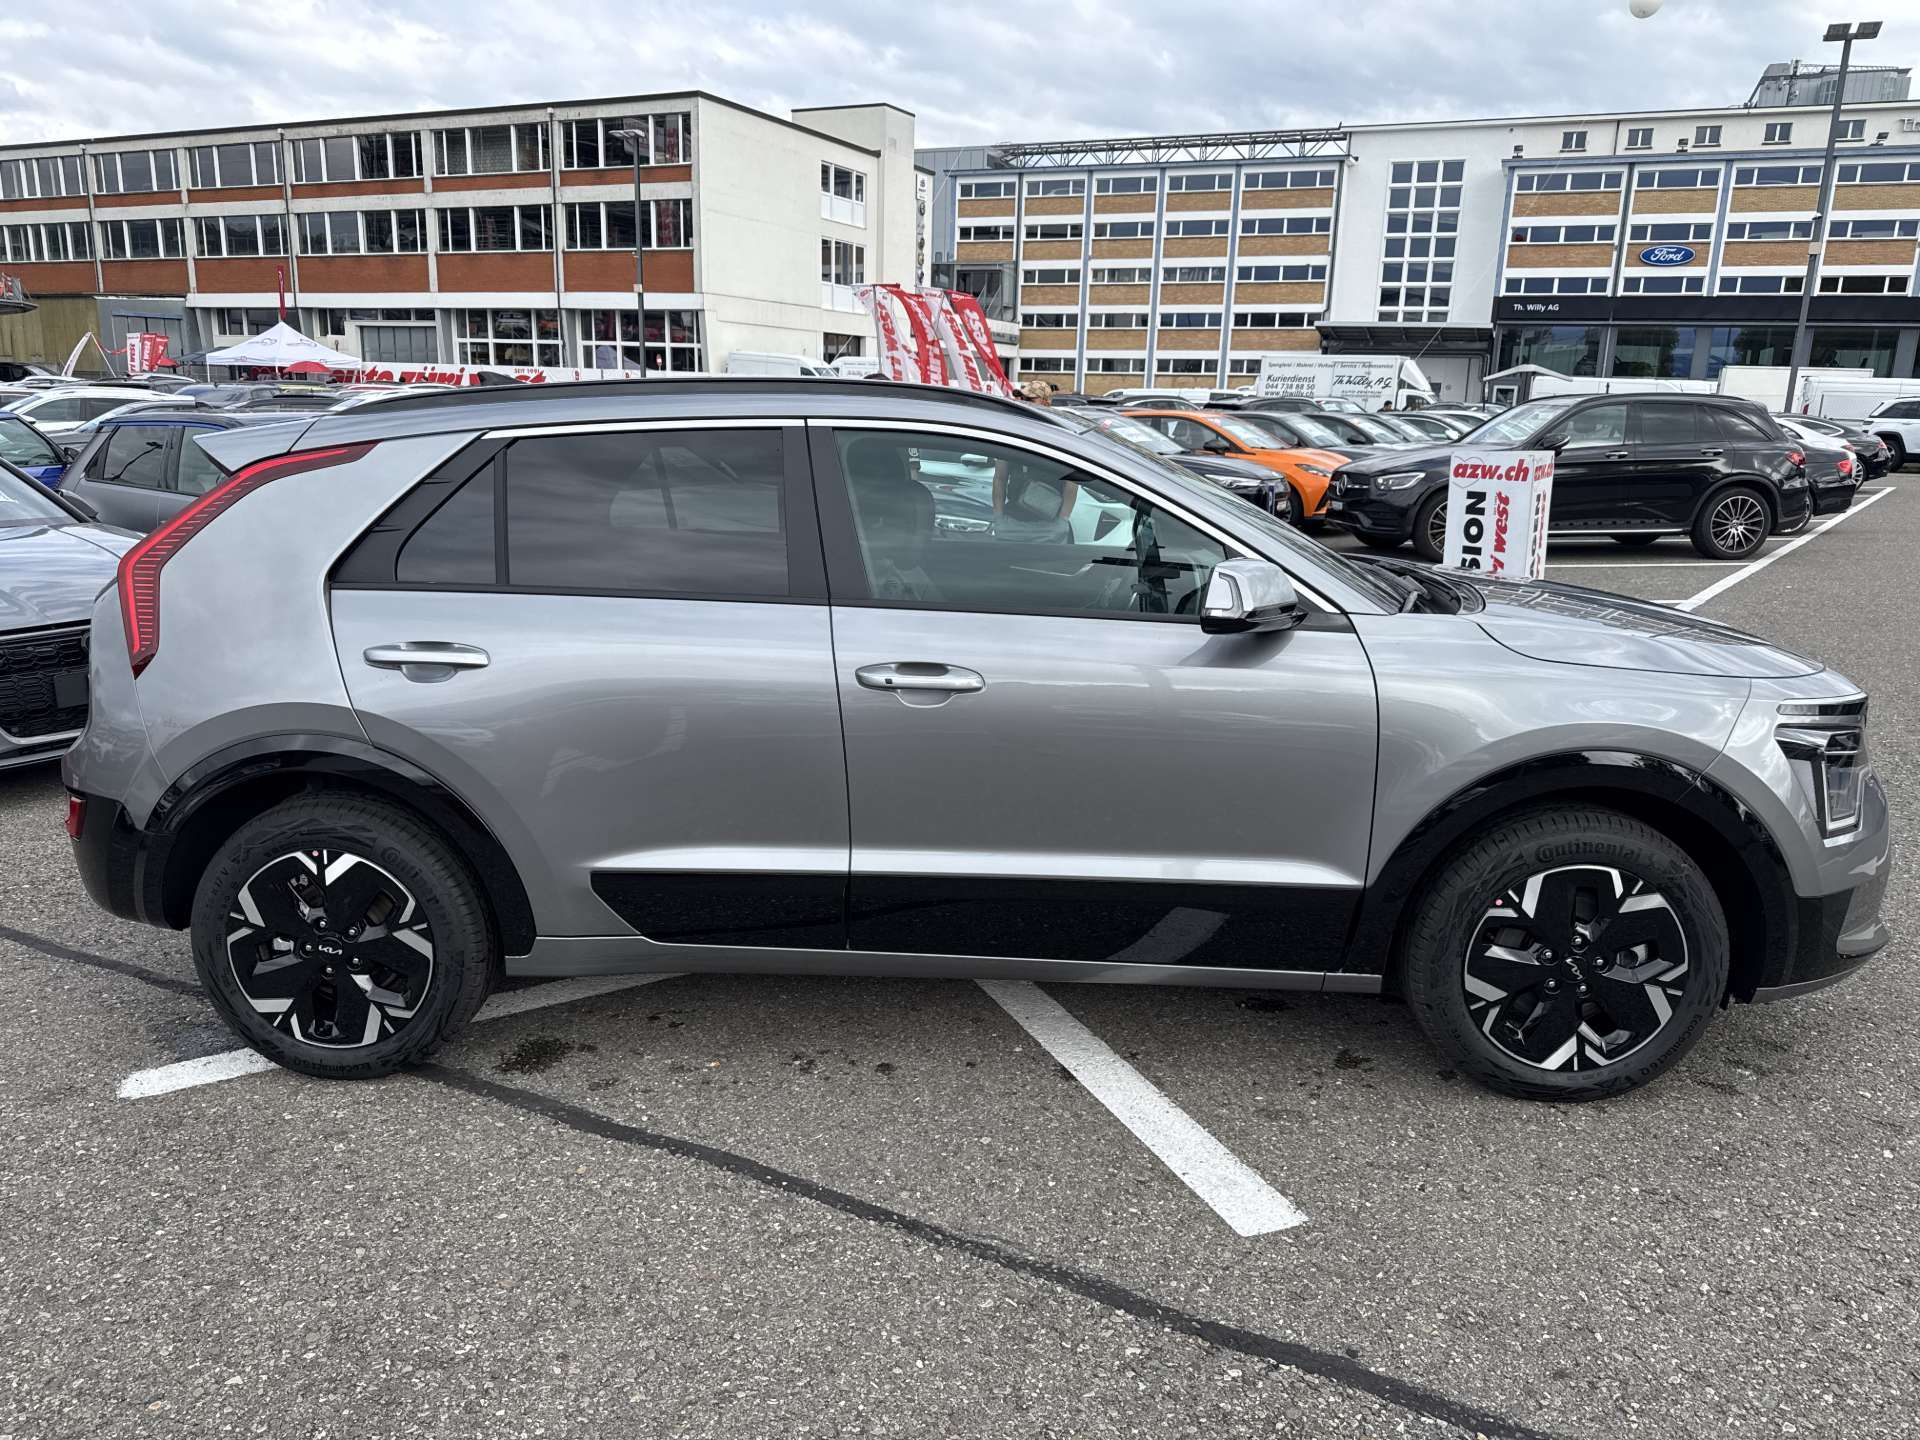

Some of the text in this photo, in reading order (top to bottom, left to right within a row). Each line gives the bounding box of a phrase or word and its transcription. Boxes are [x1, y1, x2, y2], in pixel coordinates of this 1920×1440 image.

[1650, 247, 1684, 262] Ford
[1526, 304, 1546, 312] Willy
[1266, 374, 1316, 383] Kurierdienst
[1453, 459, 1530, 482] azw.ch
[1494, 490, 1510, 553] west
[1534, 838, 1643, 863] Continental
